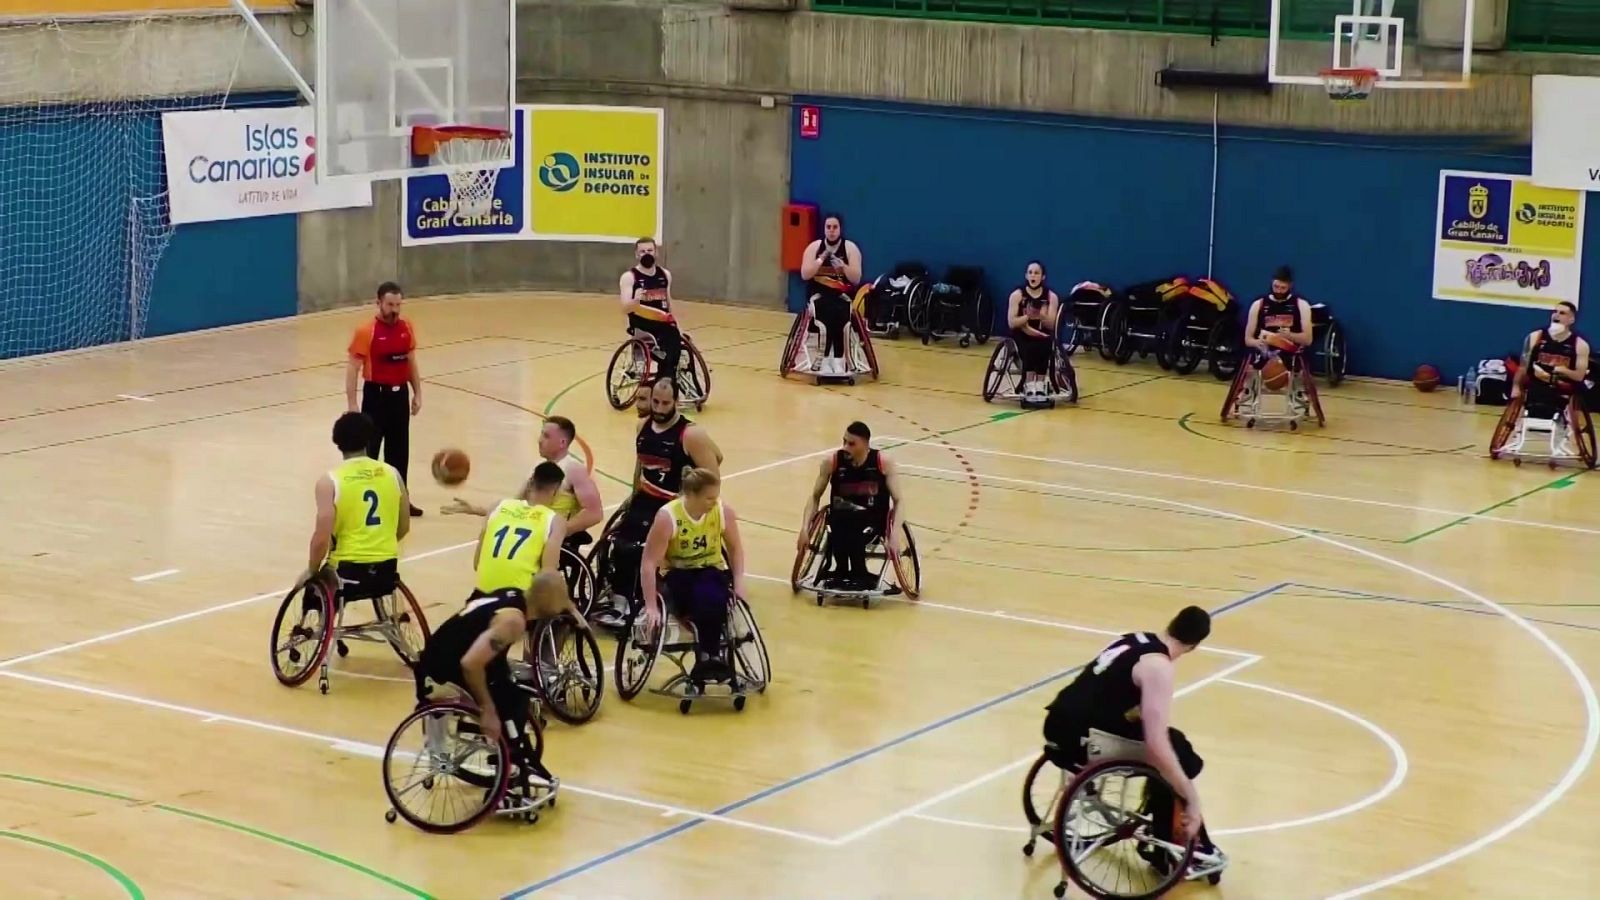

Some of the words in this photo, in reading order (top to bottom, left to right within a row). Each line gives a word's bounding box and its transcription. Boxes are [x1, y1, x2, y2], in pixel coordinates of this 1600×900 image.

[246, 124, 298, 152] Islas
[584, 153, 651, 166] INSTITUTO
[188, 152, 300, 184] Canarias
[584, 168, 635, 180] INSULAR
[1588, 167, 1600, 181] V
[238, 190, 270, 205] LATITUD
[271, 189, 281, 202] DE
[584, 183, 650, 196] DEPORTES
[416, 215, 450, 230] Gran
[453, 211, 514, 227] Canaria
[1452, 219, 1486, 230] Cabildo
[1487, 222, 1499, 230] de
[1447, 228, 1468, 237] Gran
[1471, 229, 1504, 241] Canaria
[363, 489, 381, 527] 2
[492, 525, 532, 560] 17
[693, 534, 707, 551] 54
